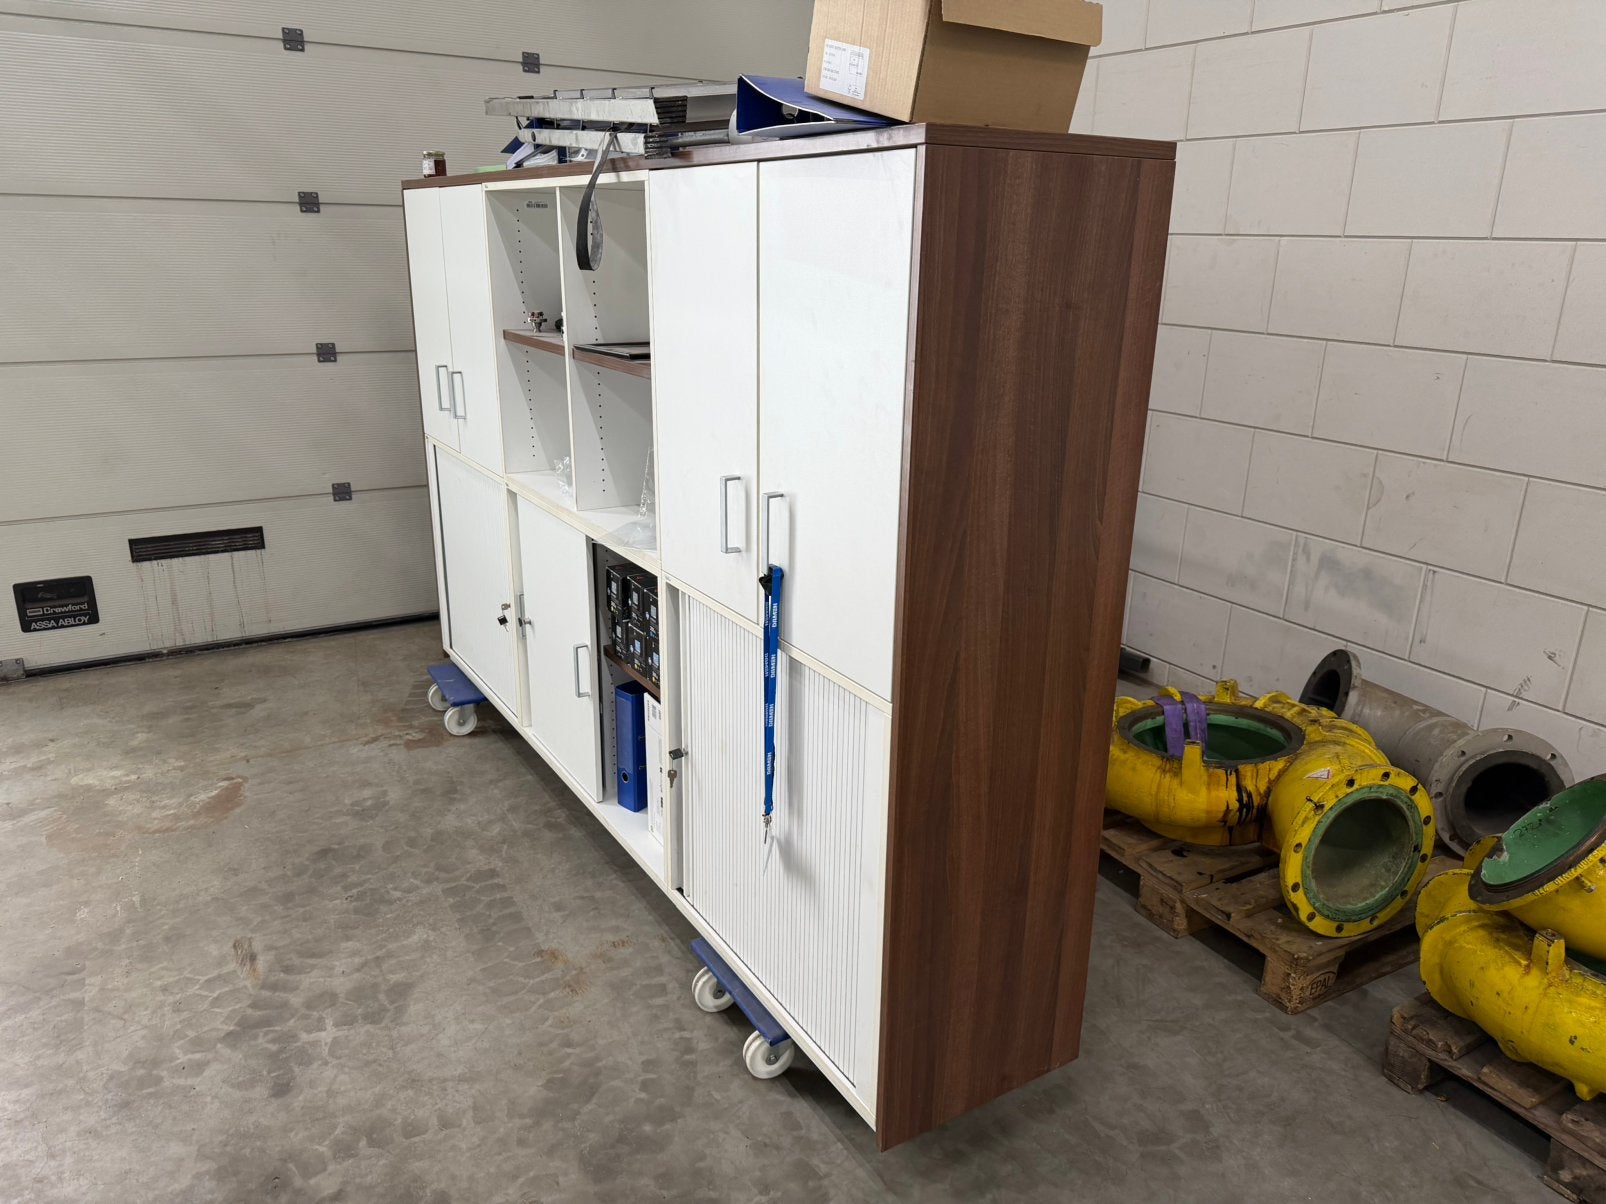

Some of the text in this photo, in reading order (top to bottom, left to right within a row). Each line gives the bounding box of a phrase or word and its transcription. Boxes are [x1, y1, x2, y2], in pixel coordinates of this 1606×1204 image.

[43, 603, 88, 614] Crawford
[31, 615, 90, 630] ASSA ABLOY
